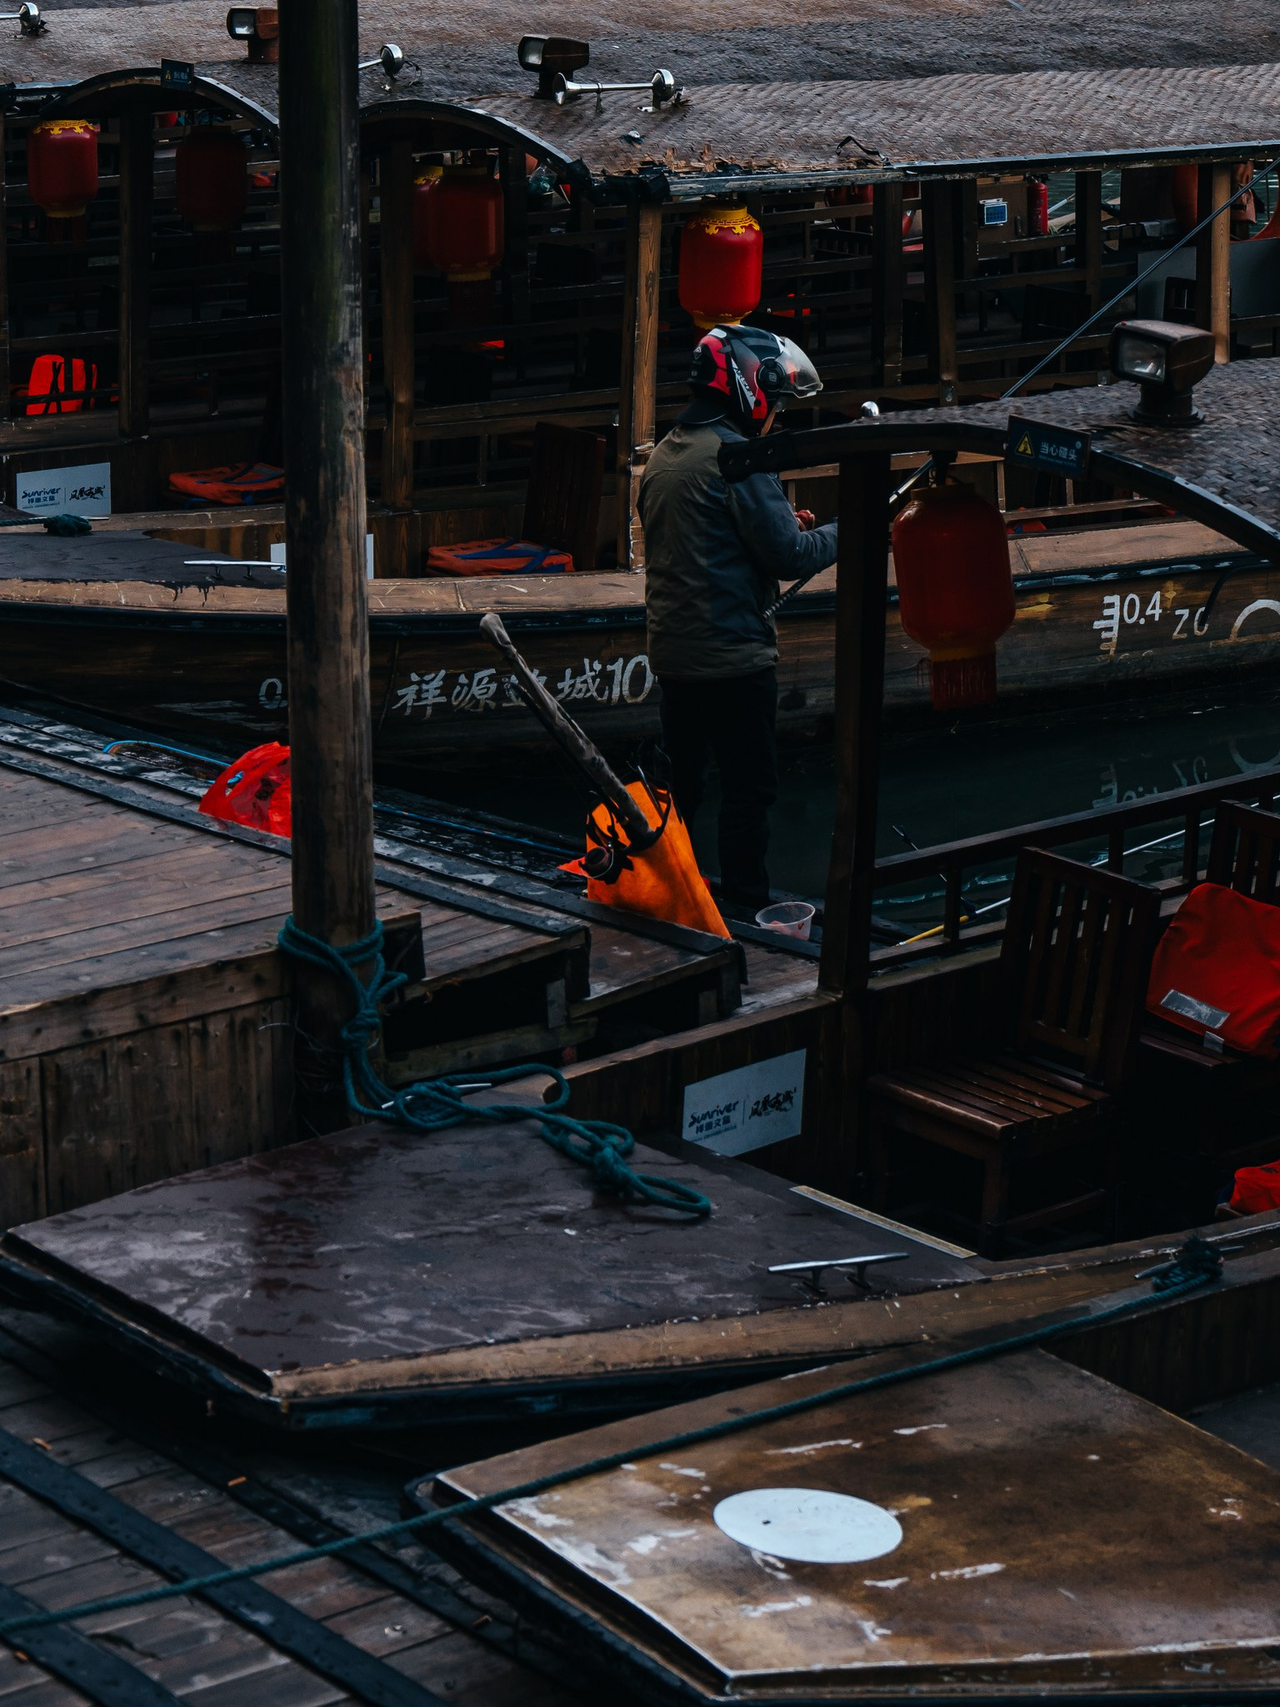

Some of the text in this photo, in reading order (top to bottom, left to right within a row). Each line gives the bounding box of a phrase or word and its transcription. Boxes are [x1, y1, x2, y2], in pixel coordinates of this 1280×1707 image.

[1040, 441, 1077, 461] 当心碰头
[22, 487, 61, 499] Sunriver
[1123, 590, 1163, 625] 0.4
[688, 1100, 739, 1128] Sunriver
